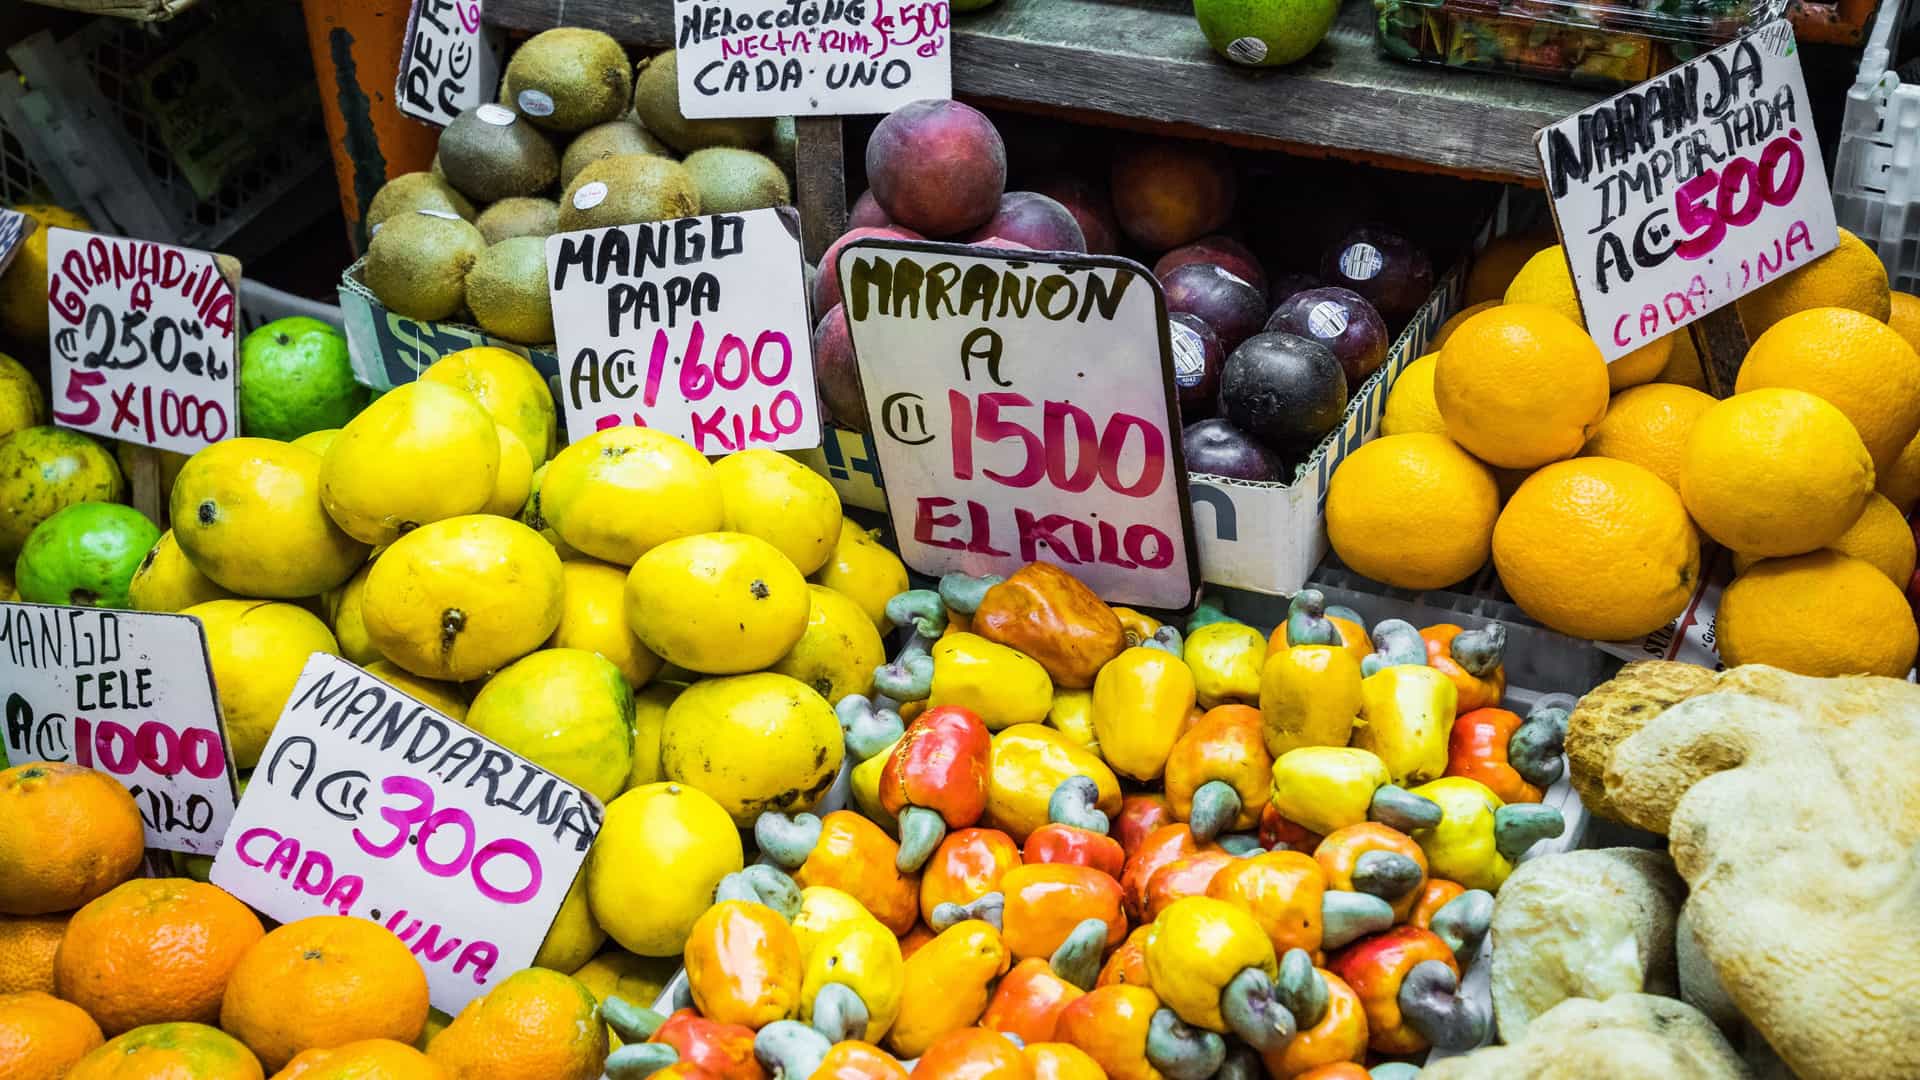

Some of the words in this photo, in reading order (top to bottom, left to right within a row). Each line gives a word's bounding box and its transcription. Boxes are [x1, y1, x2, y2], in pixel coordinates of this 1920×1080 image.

[694, 58, 802, 96] CADA
[826, 59, 912, 90] UNO
[1549, 40, 1763, 200] NARANJA
[1588, 83, 1797, 234] IMPORTADA
[554, 215, 745, 291] MANGO
[608, 272, 720, 337] PAPA
[1613, 274, 1707, 347] CADA
[960, 327, 1013, 387] A
[691, 390, 803, 452] KILO
[914, 497, 1011, 557] EL
[76, 668, 152, 711] CELE
[291, 671, 595, 851] MANDARINA
[236, 828, 364, 916] CADA
[385, 910, 499, 985] UNA
